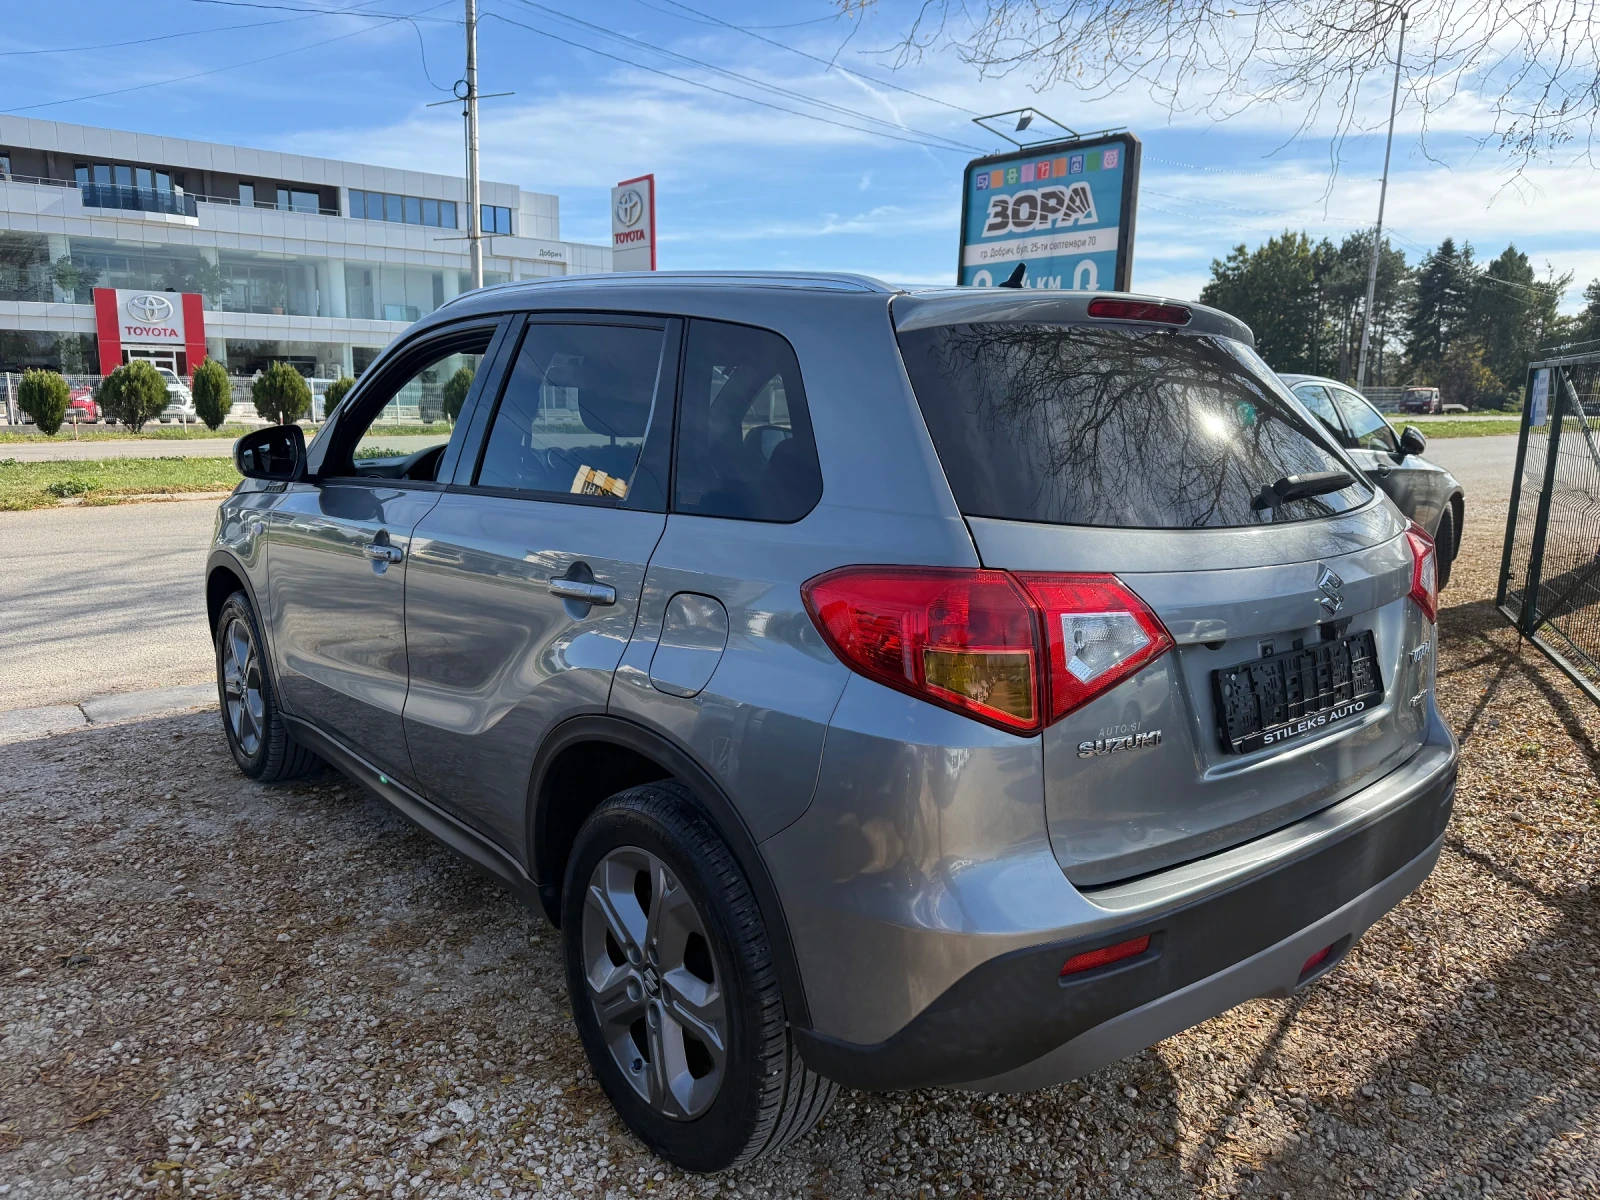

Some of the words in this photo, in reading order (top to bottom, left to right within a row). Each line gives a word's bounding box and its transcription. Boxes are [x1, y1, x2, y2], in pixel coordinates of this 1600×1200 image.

[983, 182, 1097, 236] ЗОРА
[615, 229, 645, 244] TOYOTA
[1030, 242, 1048, 252] 25-ти
[1049, 239, 1086, 250] септември
[1087, 235, 1097, 247] 70
[539, 248, 562, 258] Добрич
[124, 326, 179, 338] TOYOTA
[1263, 715, 1326, 744] STILEKS
[1328, 701, 1365, 721] AUTO
[1077, 730, 1162, 758] SUZUKI
